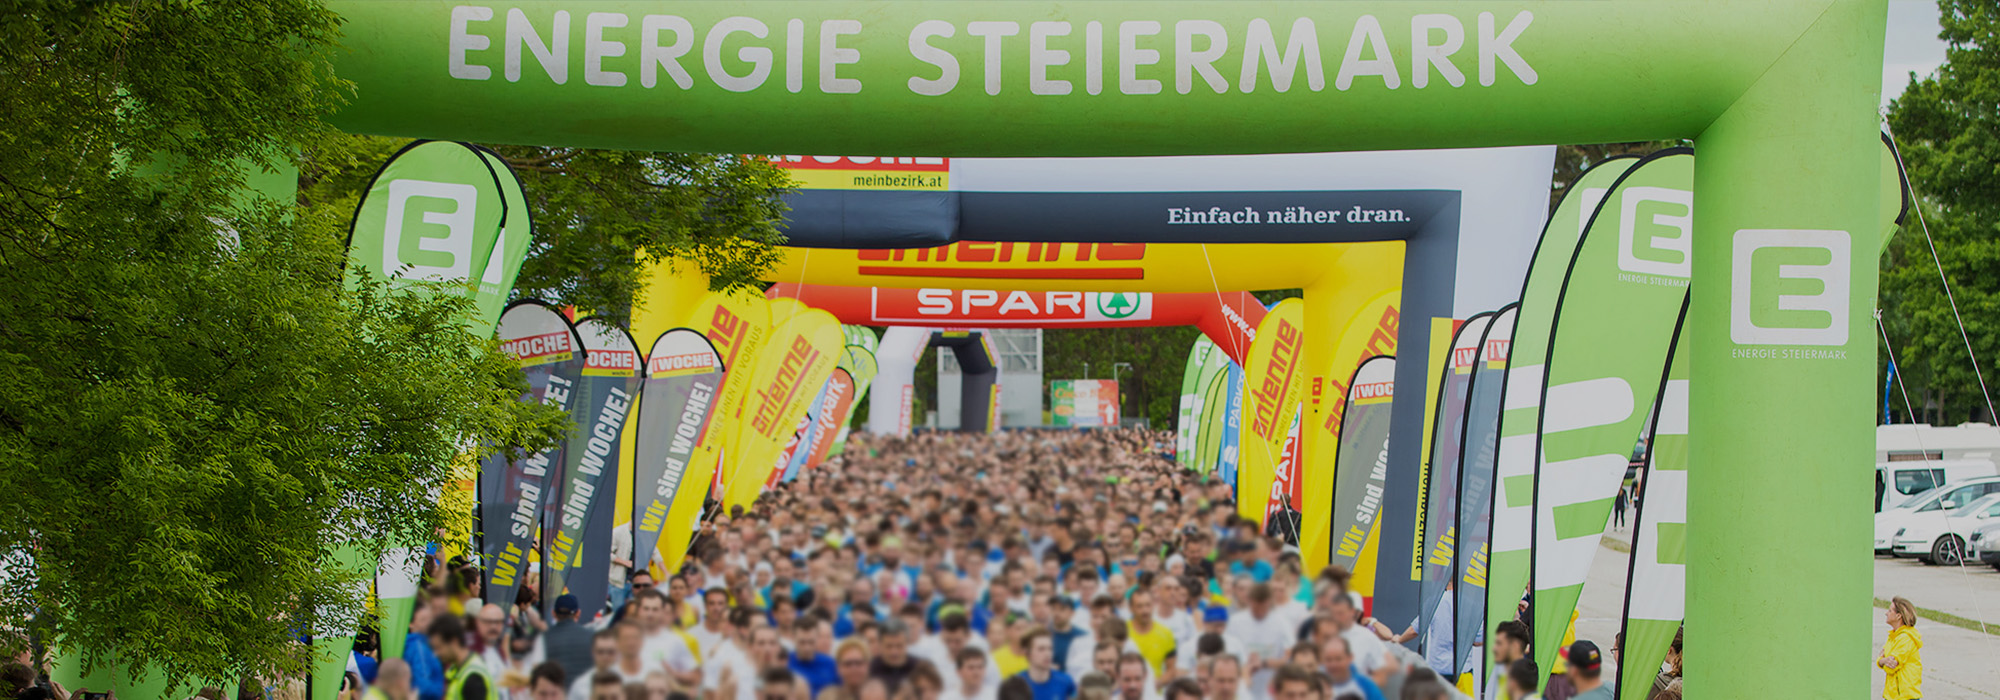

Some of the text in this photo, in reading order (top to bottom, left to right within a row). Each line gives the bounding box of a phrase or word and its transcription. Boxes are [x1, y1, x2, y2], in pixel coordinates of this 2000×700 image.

[448, 5, 1539, 96] ENERGIE STEIERMARK
[853, 174, 942, 188] meinbezirk.at
[1167, 205, 1411, 225] Einfach näher dran.
[1618, 273, 1690, 288] ENERGIE STEIERMAR
[917, 287, 1082, 316] SPAR
[587, 350, 633, 368] OCHE
[1732, 348, 1847, 360] ENERGIE STEIERMARK
[752, 334, 814, 435] antenne
[1252, 317, 1298, 439] antenne
[669, 381, 714, 456] WOCHE!
[547, 386, 633, 572] Wir sind WOCHE!
[657, 460, 684, 499] sind
[491, 541, 524, 588] Wir
[511, 481, 541, 540] sind
[639, 498, 668, 534] Wir
[1337, 524, 1365, 559] Wir
[1355, 483, 1384, 525] sind
